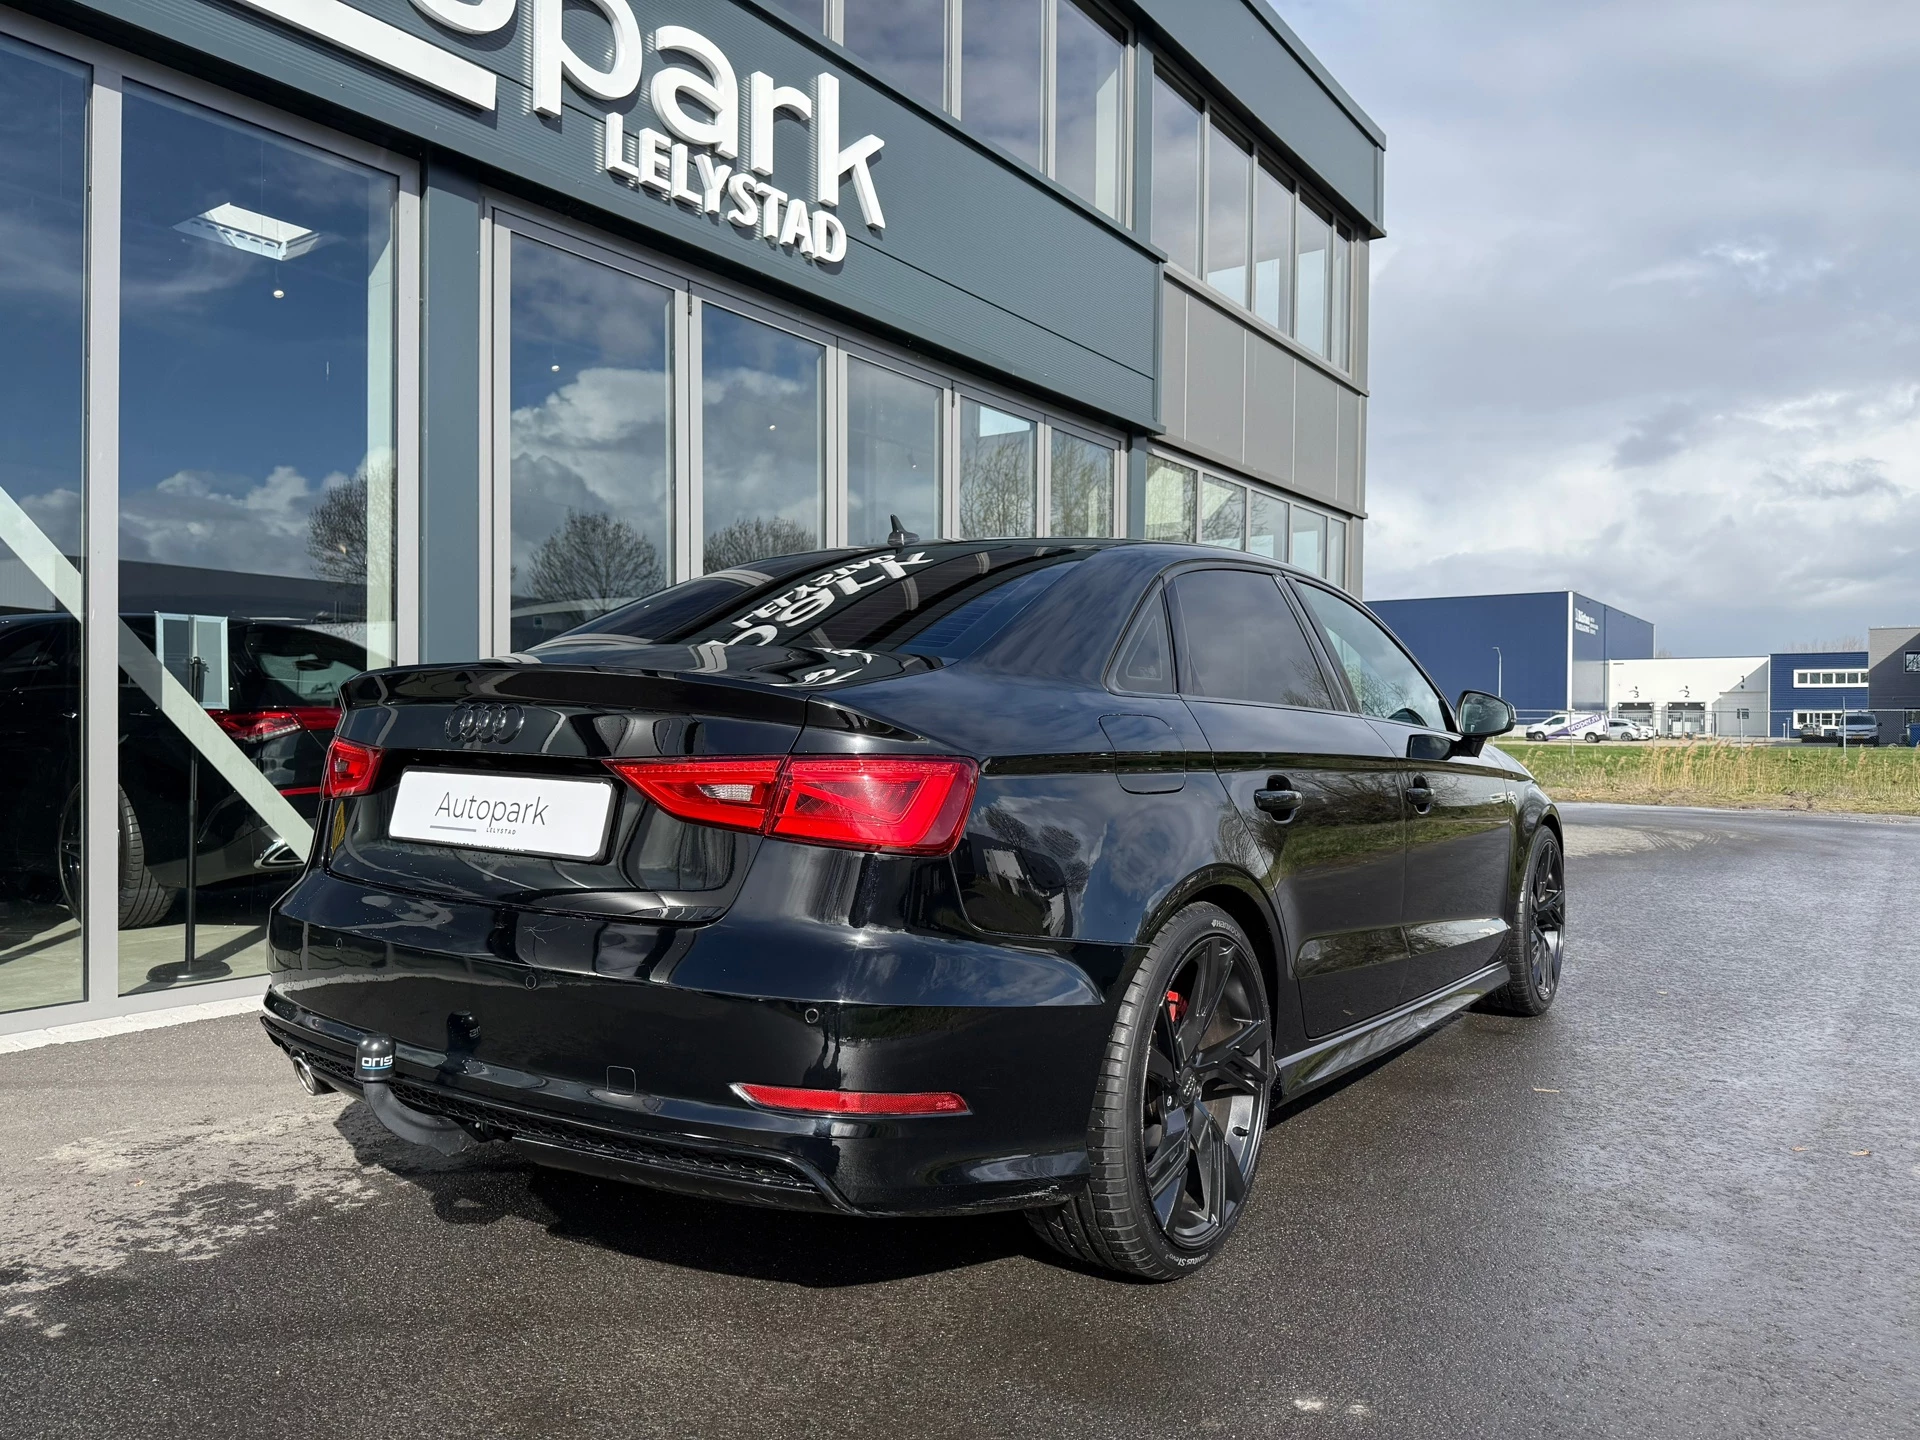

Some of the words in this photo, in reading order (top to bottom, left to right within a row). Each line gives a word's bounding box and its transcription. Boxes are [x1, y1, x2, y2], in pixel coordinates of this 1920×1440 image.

[606, 112, 847, 263] LELYSTAD
[434, 791, 549, 828] Autopark
[485, 827, 516, 836] LELYSTAD
